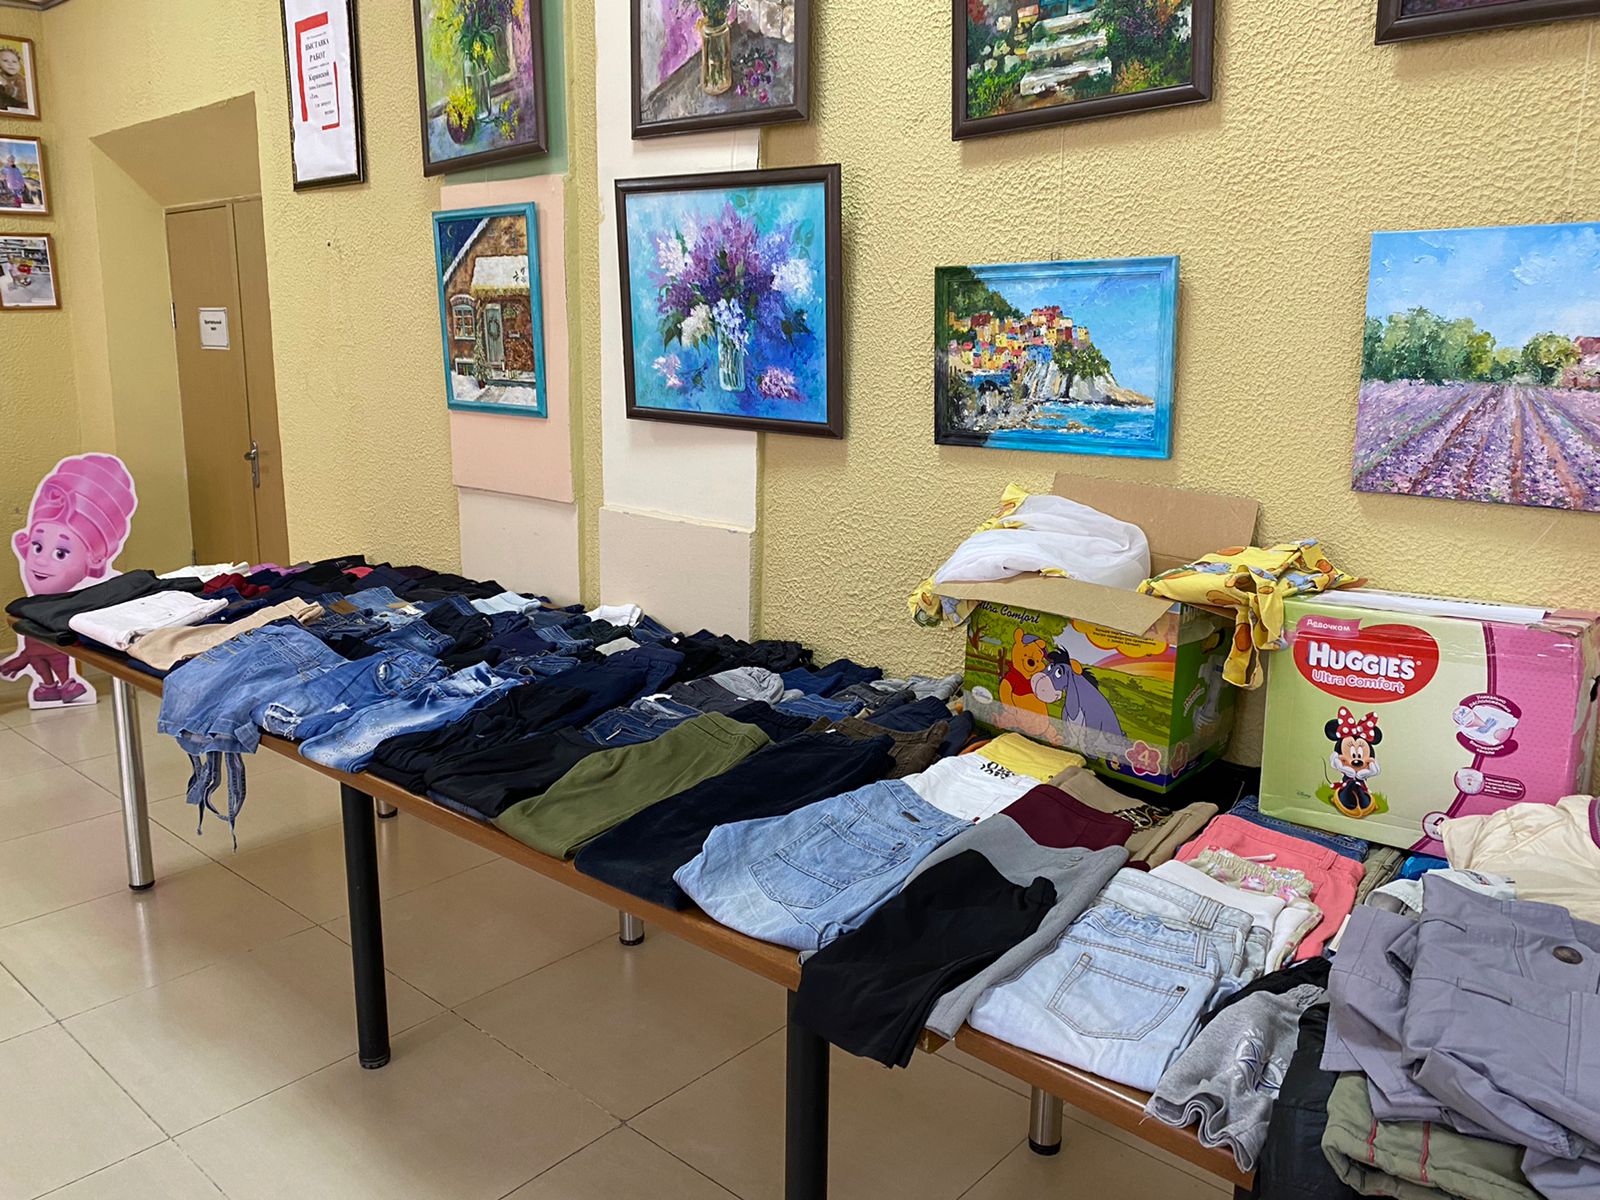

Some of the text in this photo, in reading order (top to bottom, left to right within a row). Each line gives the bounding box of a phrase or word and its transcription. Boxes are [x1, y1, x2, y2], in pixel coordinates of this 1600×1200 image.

[309, 50, 326, 62] РАБОТ
[1000, 604, 1040, 625] Comfort
[1306, 619, 1351, 632] Девочкам
[1308, 640, 1416, 681] HUGGIES
[1312, 669, 1406, 695] Ultra Comfort
[1138, 750, 1150, 767] 4
